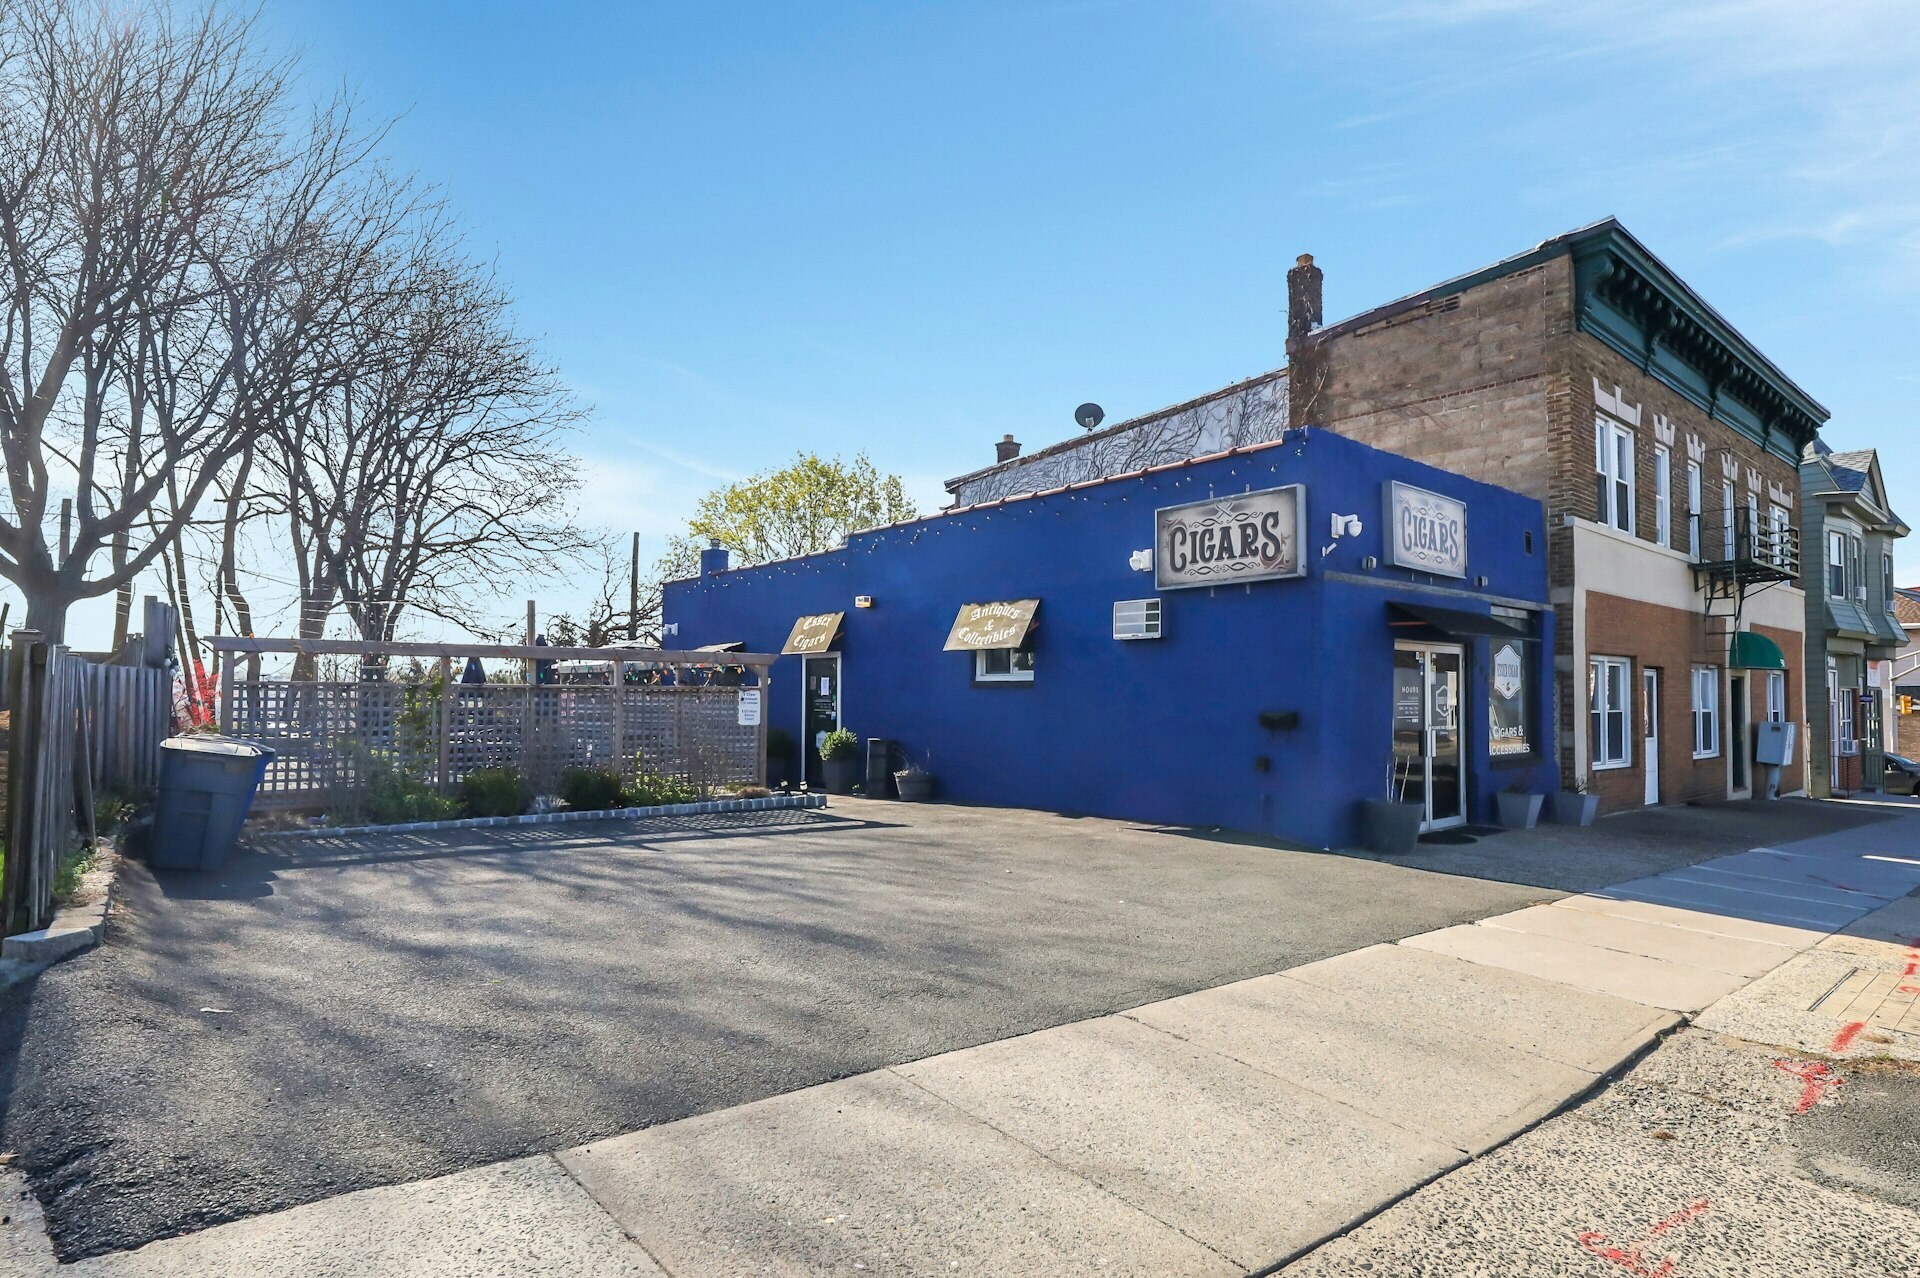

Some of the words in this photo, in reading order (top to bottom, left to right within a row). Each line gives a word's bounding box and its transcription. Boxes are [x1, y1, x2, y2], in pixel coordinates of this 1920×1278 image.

[1169, 511, 1281, 573] CIGARS
[1402, 506, 1459, 562] CIGARS
[969, 603, 1022, 622] Antiques
[803, 615, 832, 630] Essex
[984, 619, 994, 631] &
[793, 632, 827, 651] Cigars
[957, 625, 1017, 645] Collectibles
[1493, 726, 1517, 738] CIGARS
[1518, 725, 1524, 736] &
